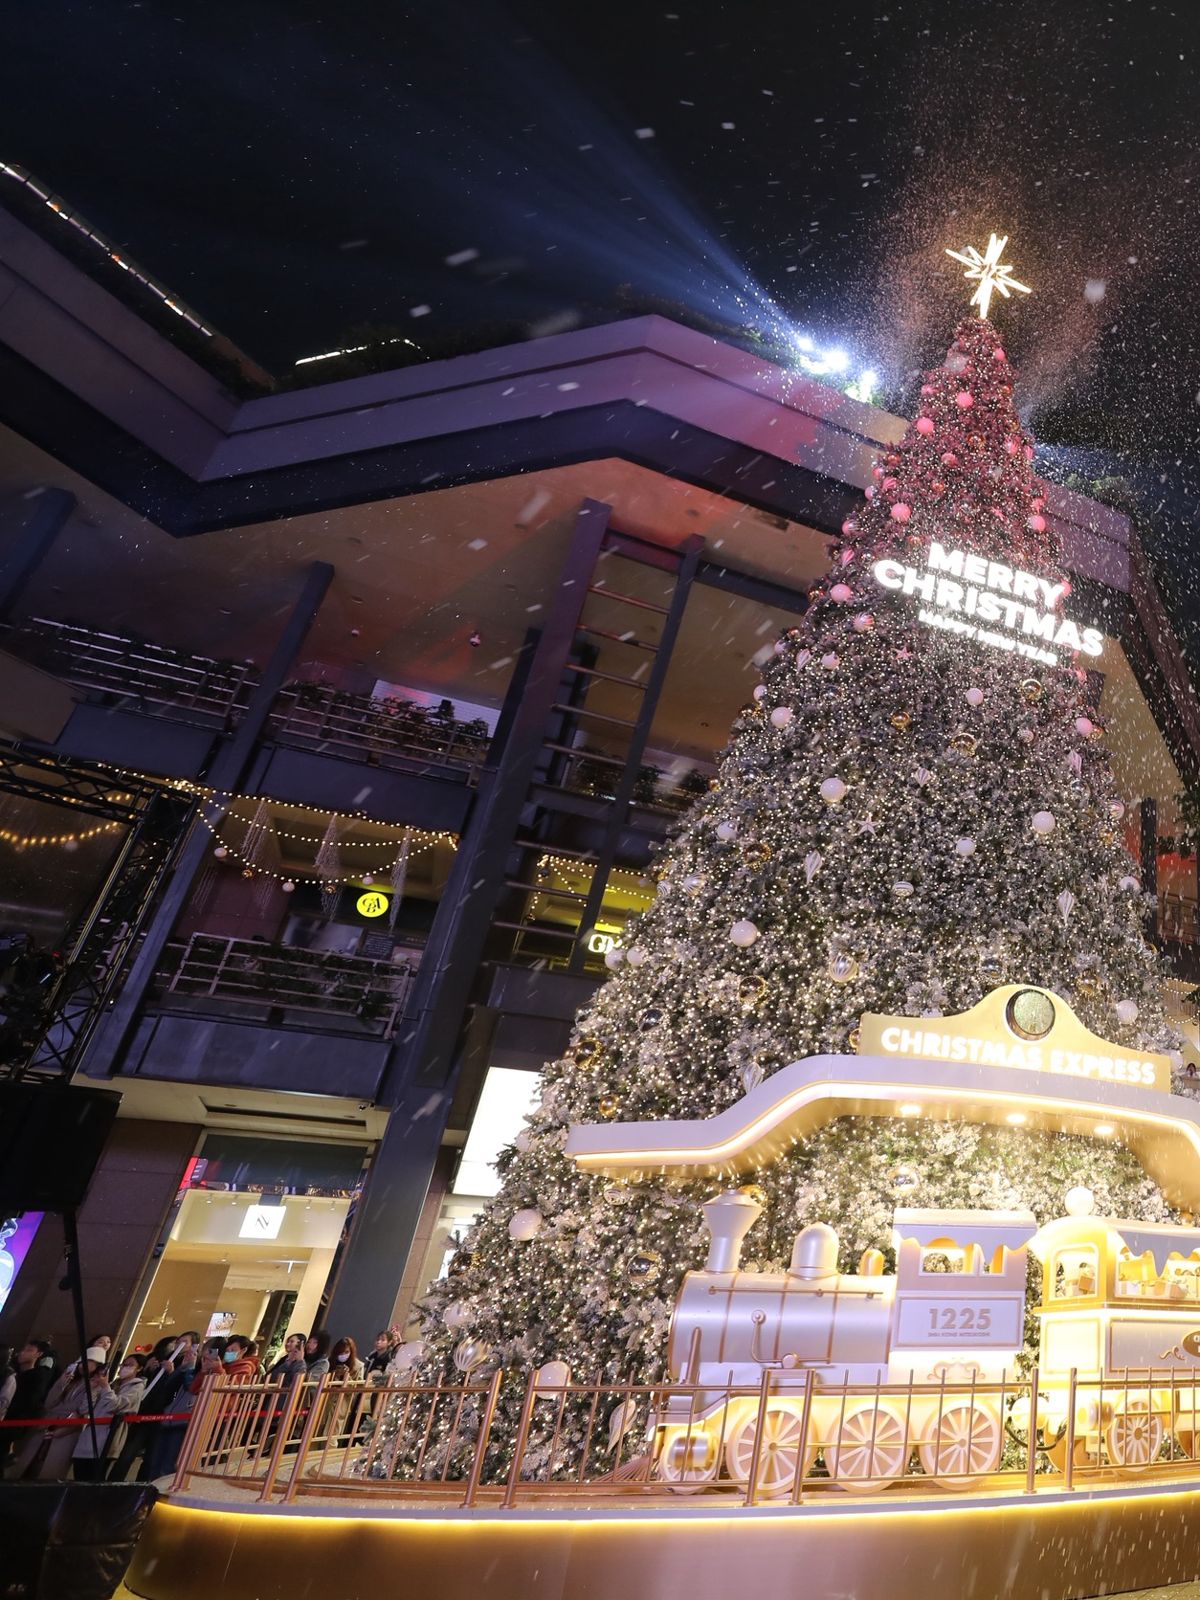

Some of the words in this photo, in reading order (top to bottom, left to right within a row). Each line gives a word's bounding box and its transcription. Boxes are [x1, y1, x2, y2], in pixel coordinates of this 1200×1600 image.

[927, 542, 1065, 608] MERRY
[874, 559, 1104, 657] CHRISTMAS
[919, 609, 977, 638] HAPPY
[881, 1027, 1043, 1070] CHRISTMAS
[1051, 1050, 1156, 1085] EXPRESS
[928, 1307, 992, 1330] 1225
